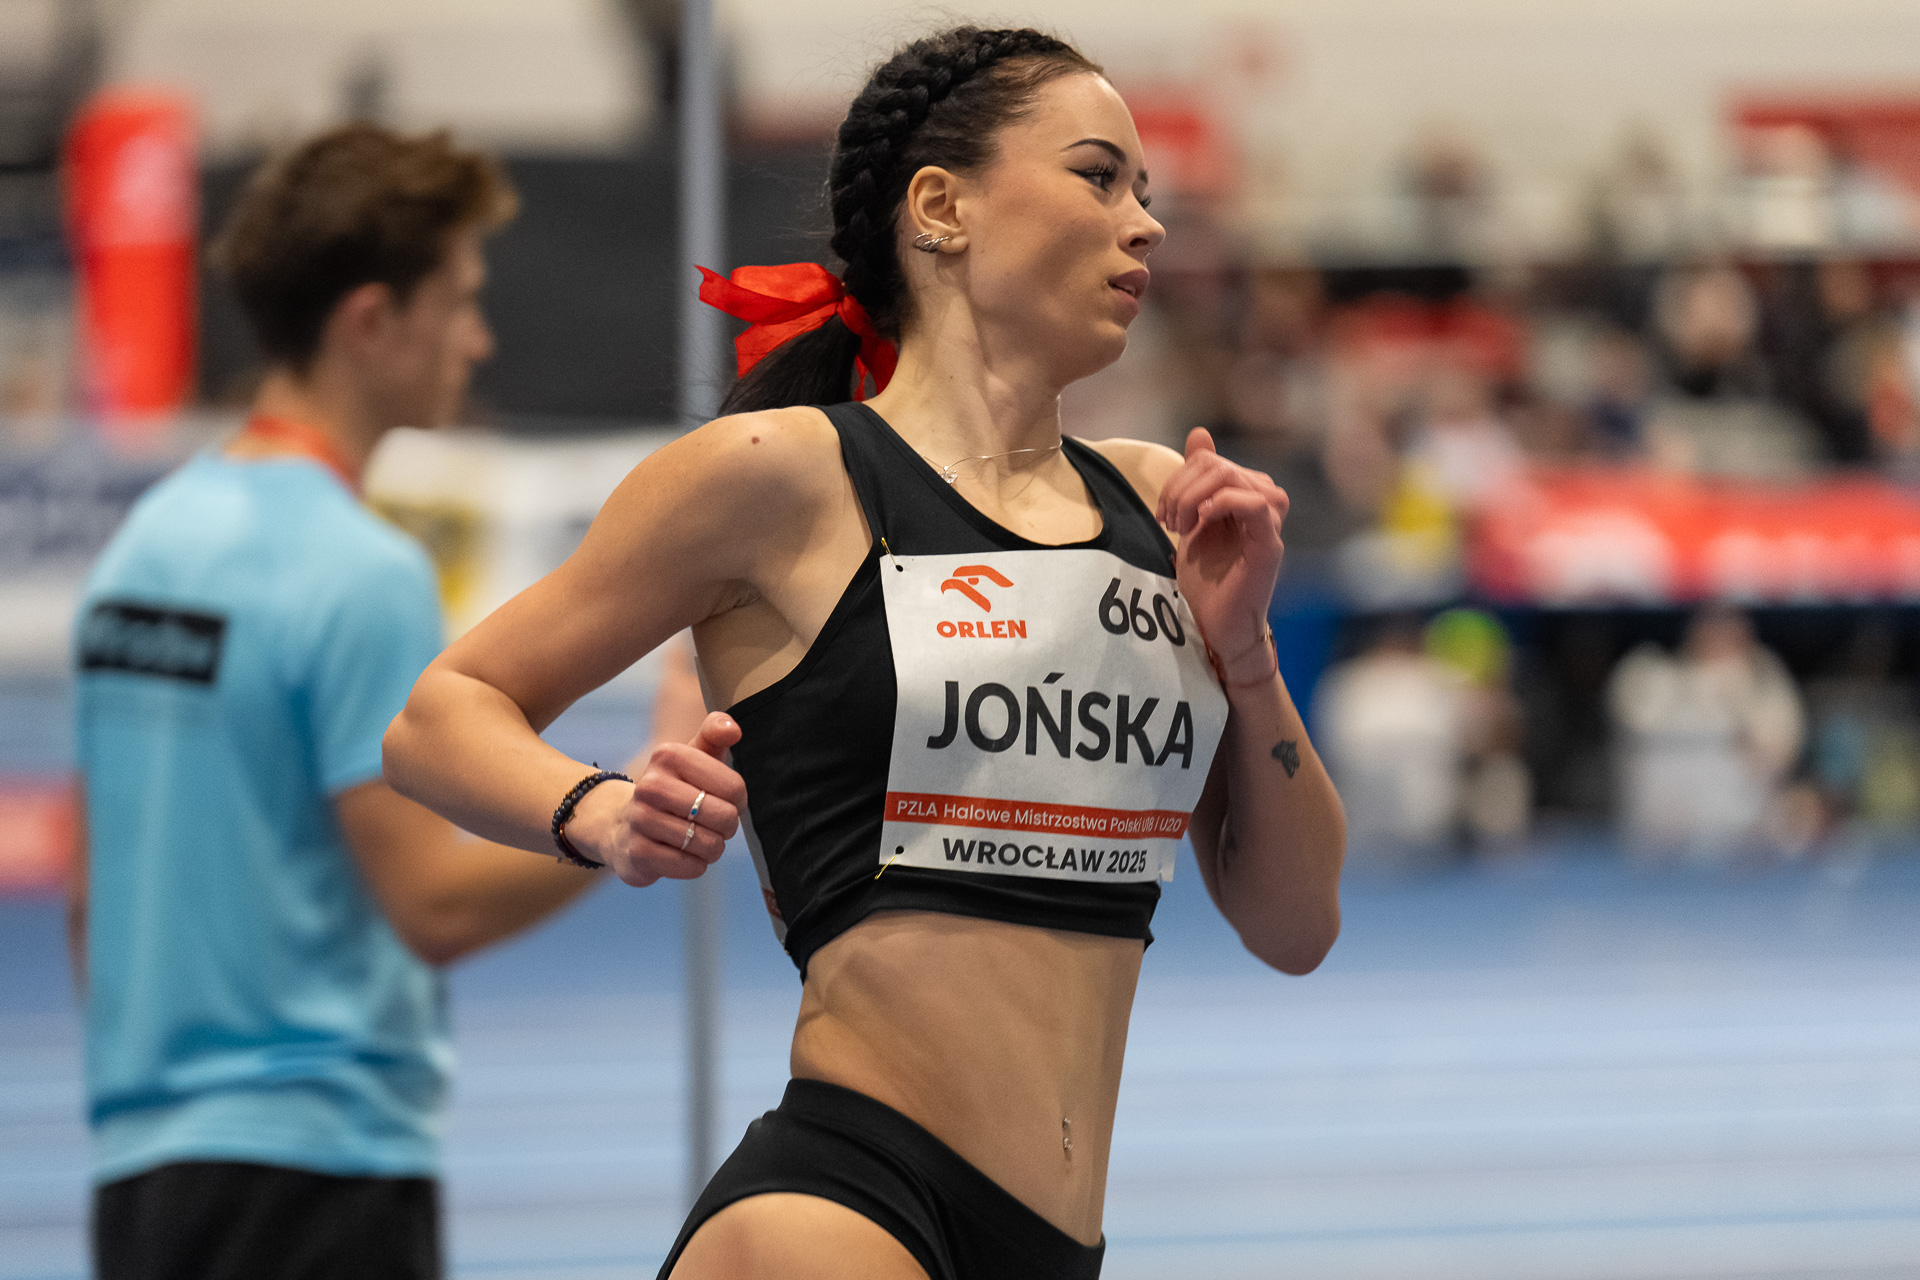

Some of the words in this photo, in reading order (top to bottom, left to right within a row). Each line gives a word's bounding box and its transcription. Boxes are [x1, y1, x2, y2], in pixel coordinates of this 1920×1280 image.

[936, 620, 1027, 639] ORLEN
[1099, 577, 1186, 647] 660
[926, 672, 1194, 769] JOŃSKA
[896, 800, 938, 818] PZLA
[944, 803, 1010, 823] Halowe
[1015, 809, 1107, 831] Mistrzostwa
[1110, 816, 1141, 833] Polski
[1160, 817, 1182, 833] U20
[942, 838, 1105, 873] WROCŁAW
[1106, 850, 1148, 873] 2025
